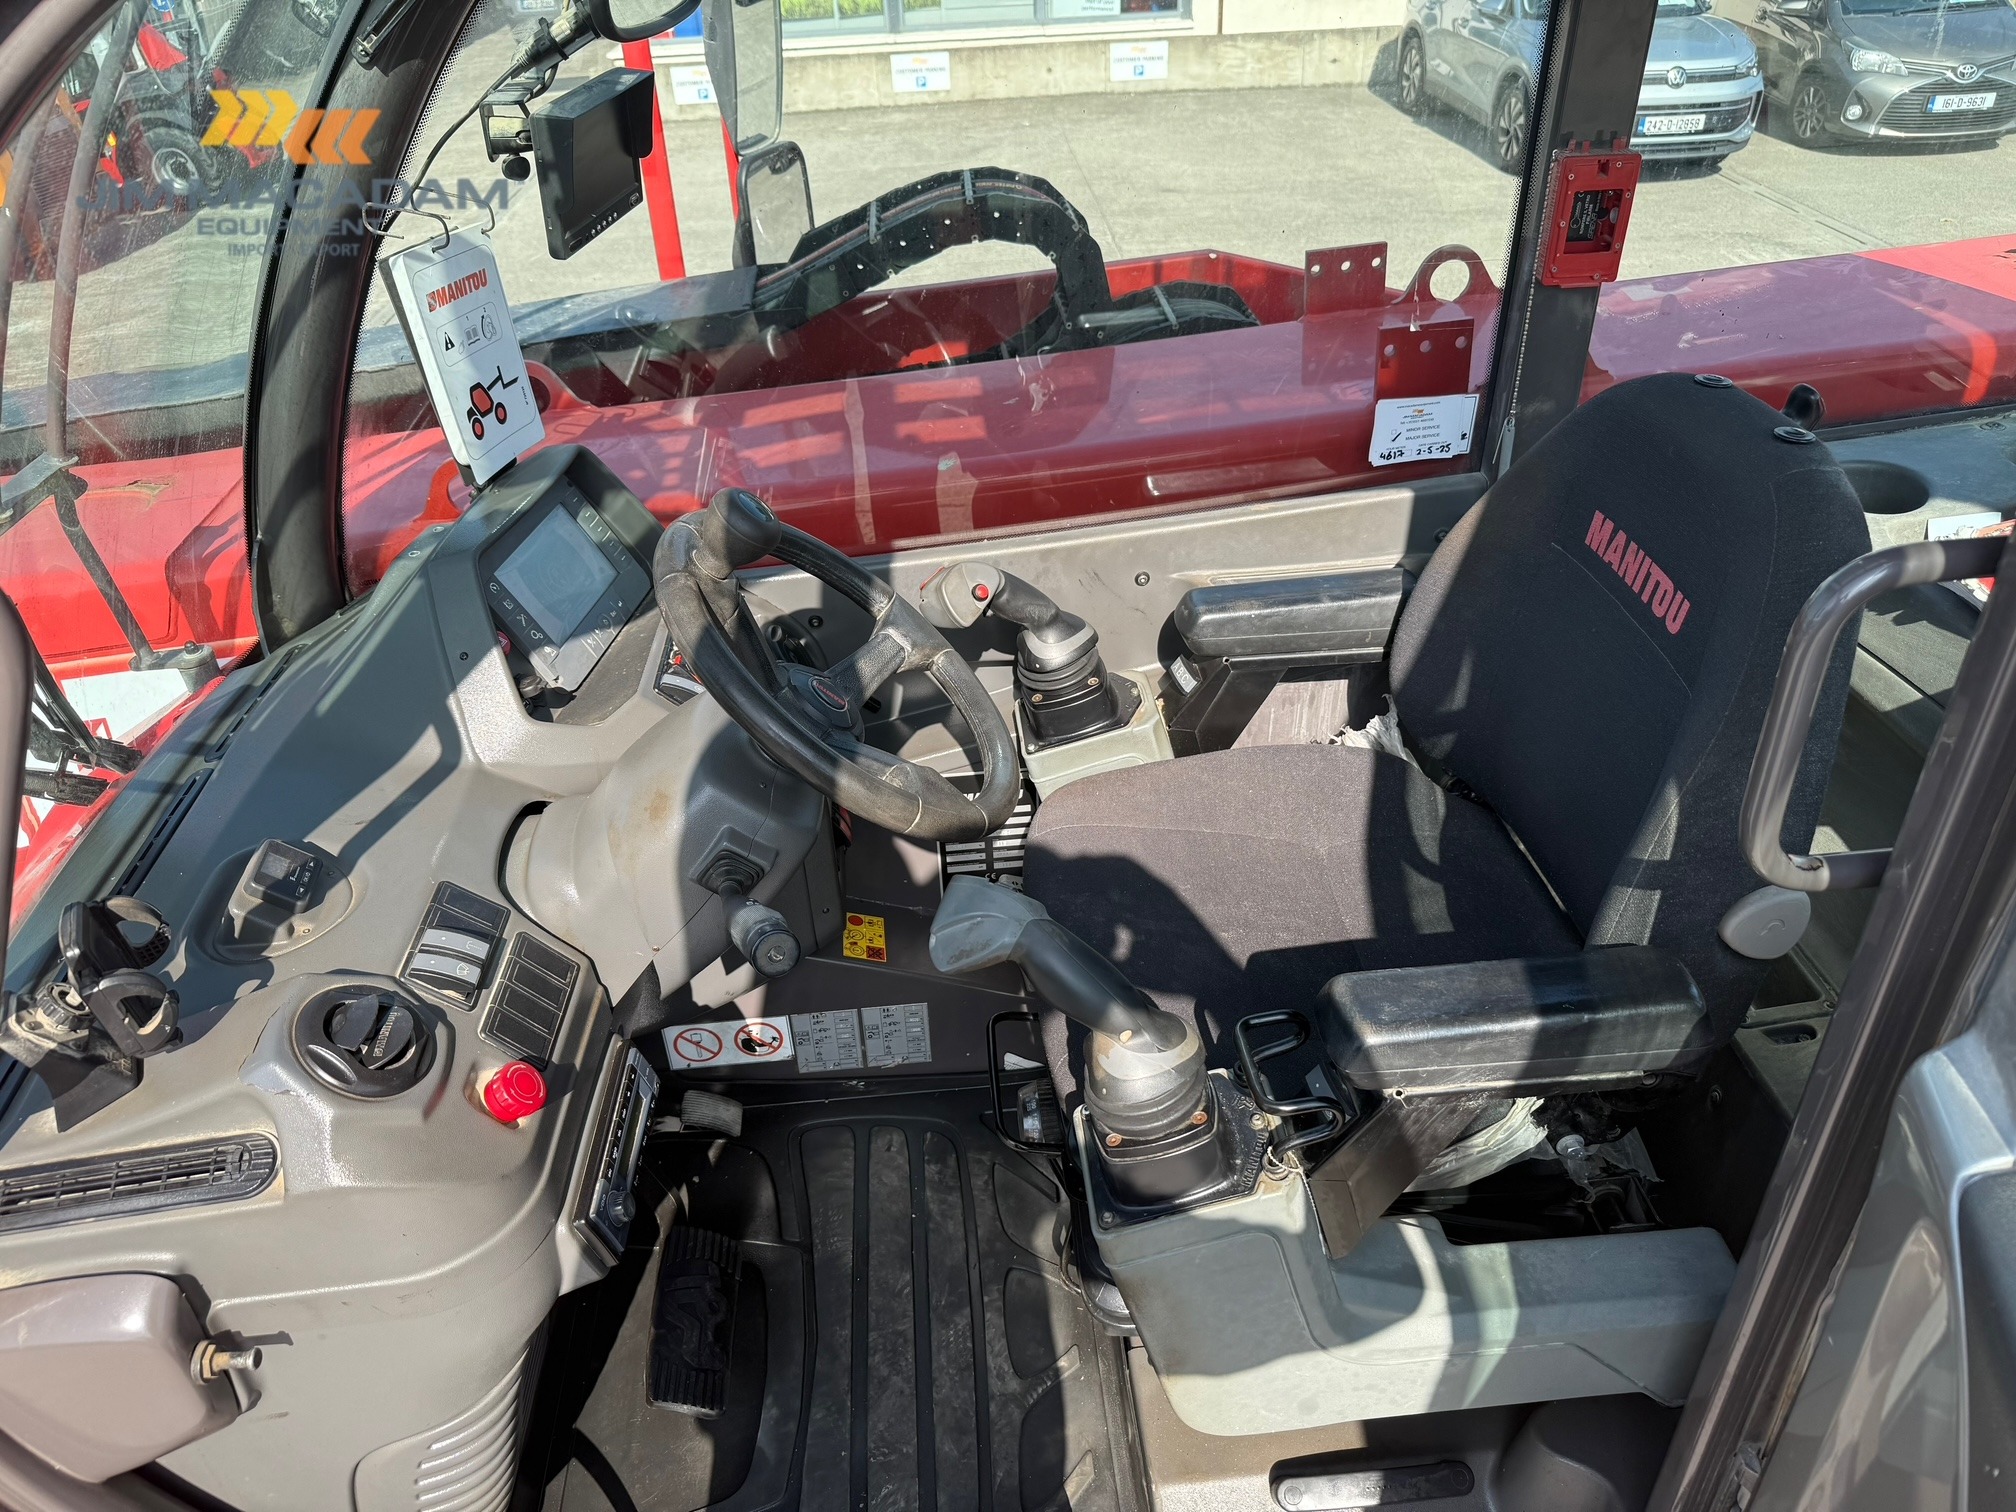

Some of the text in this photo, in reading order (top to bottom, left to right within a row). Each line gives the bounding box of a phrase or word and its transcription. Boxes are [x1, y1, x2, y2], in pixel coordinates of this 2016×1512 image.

[1942, 96, 1987, 109] 161-D-9631
[436, 268, 488, 308] MANITOU
[1380, 449, 1405, 461] 4617
[1585, 510, 1691, 635] MANITOU
[374, 1012, 398, 1050] MANITOU
